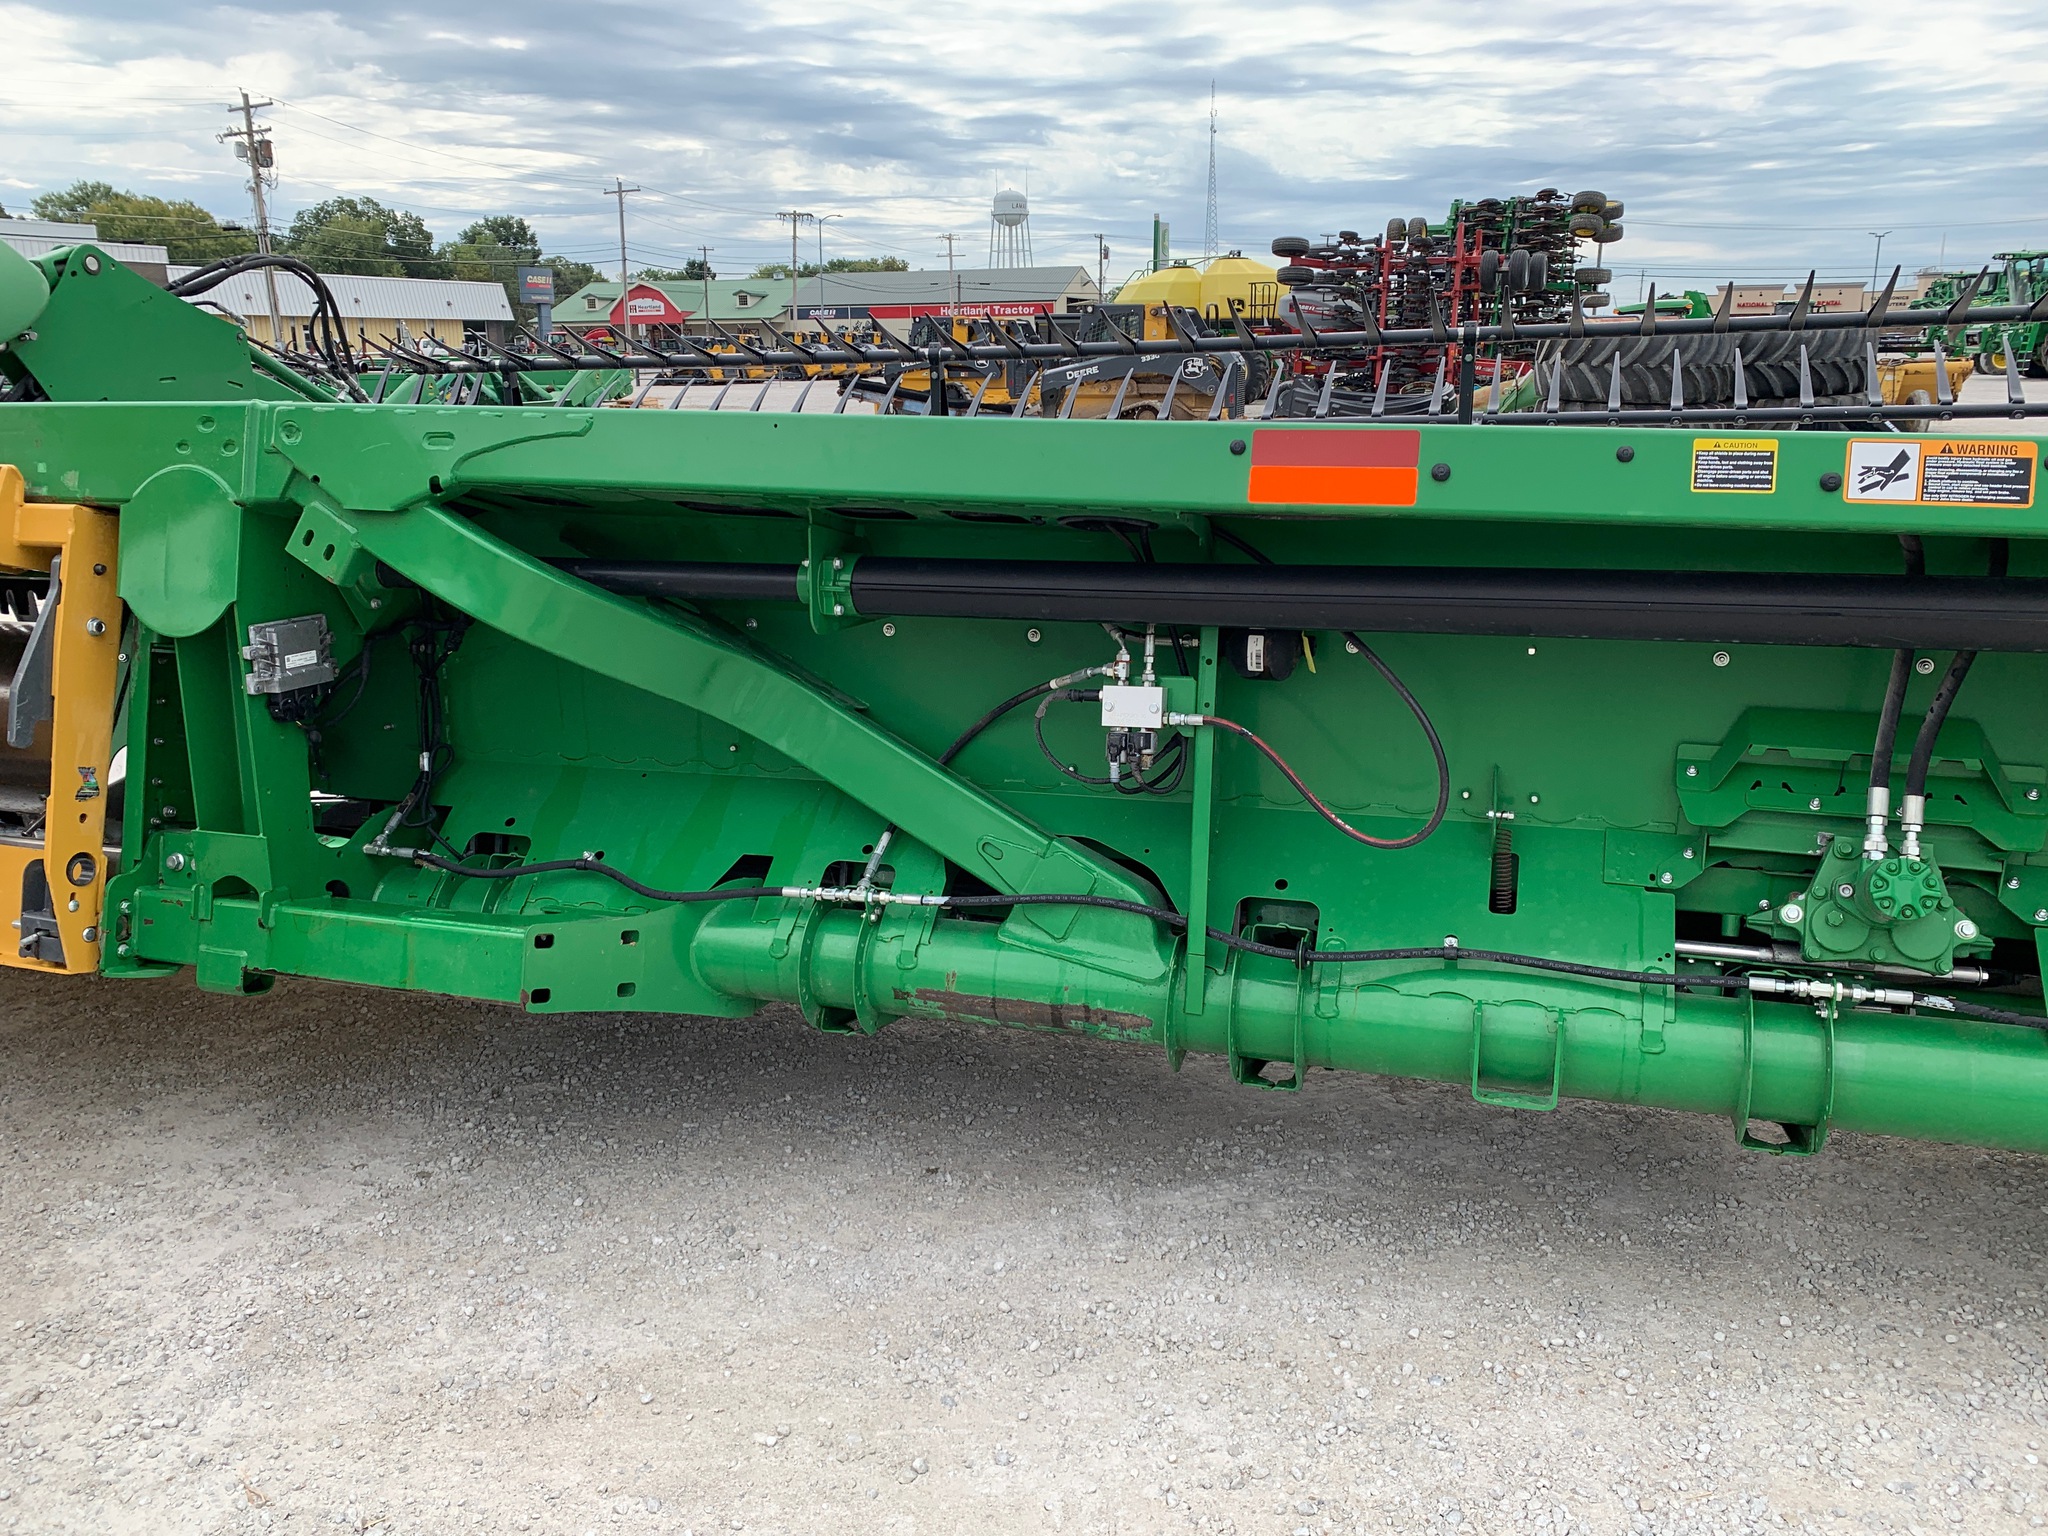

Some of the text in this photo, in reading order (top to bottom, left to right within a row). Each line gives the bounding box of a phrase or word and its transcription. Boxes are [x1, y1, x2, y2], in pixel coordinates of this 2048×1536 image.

[527, 275, 546, 284] CASE
[993, 306, 1035, 315] Tractor
[1066, 366, 1100, 380] DEERE
[1956, 444, 2018, 456] WARNING
